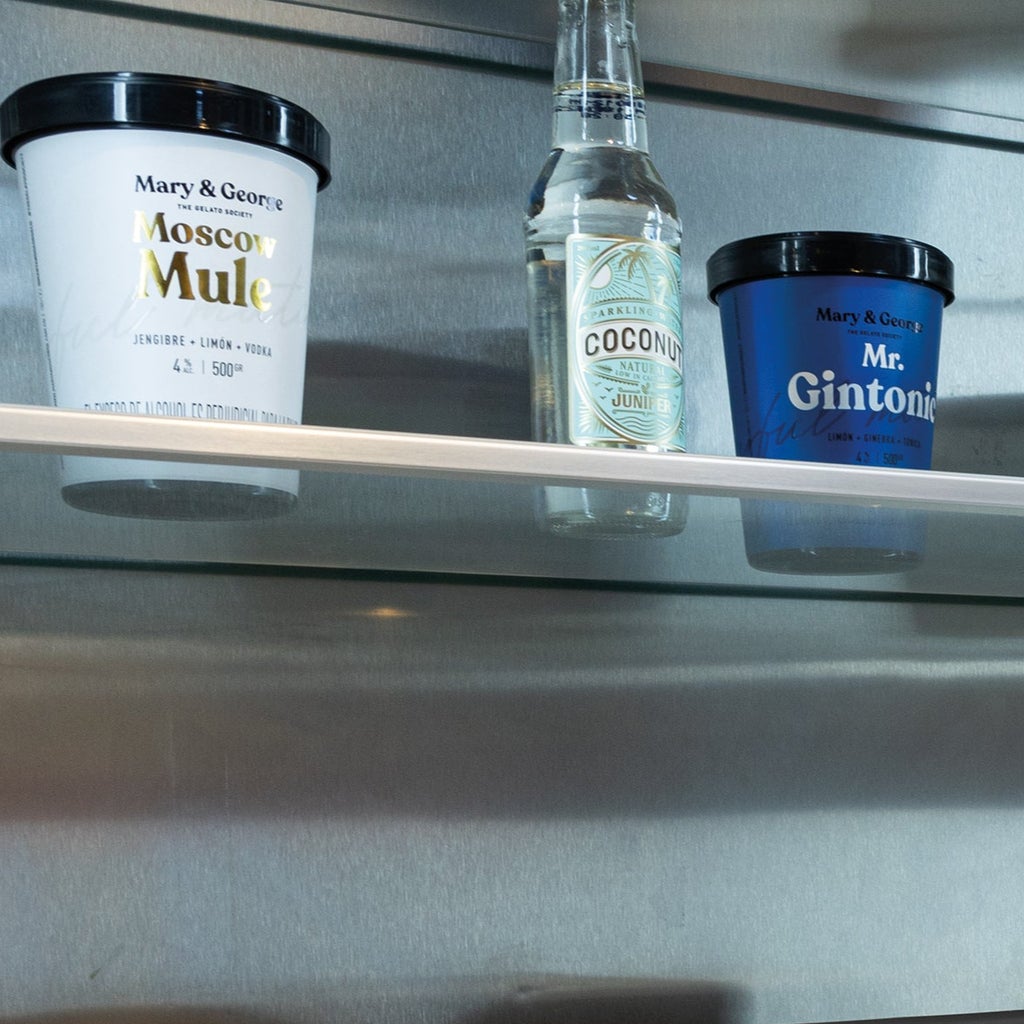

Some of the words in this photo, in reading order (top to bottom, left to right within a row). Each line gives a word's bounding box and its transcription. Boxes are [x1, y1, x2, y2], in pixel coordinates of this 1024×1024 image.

[135, 174, 194, 200] Mary
[199, 179, 217, 198] &
[221, 182, 284, 212] George
[177, 203, 192, 211] THE
[195, 206, 223, 215] GELATO
[225, 209, 253, 219] SOCIETY
[132, 210, 277, 259] Moscow
[137, 248, 272, 312] Mule
[816, 307, 860, 326] Mary
[864, 310, 876, 324] &
[133, 333, 185, 347] JENGIBRE
[200, 335, 232, 351] LIMÓN
[245, 342, 272, 358] VODKA
[585, 327, 682, 373] COCONUT
[862, 342, 904, 371] Mr.
